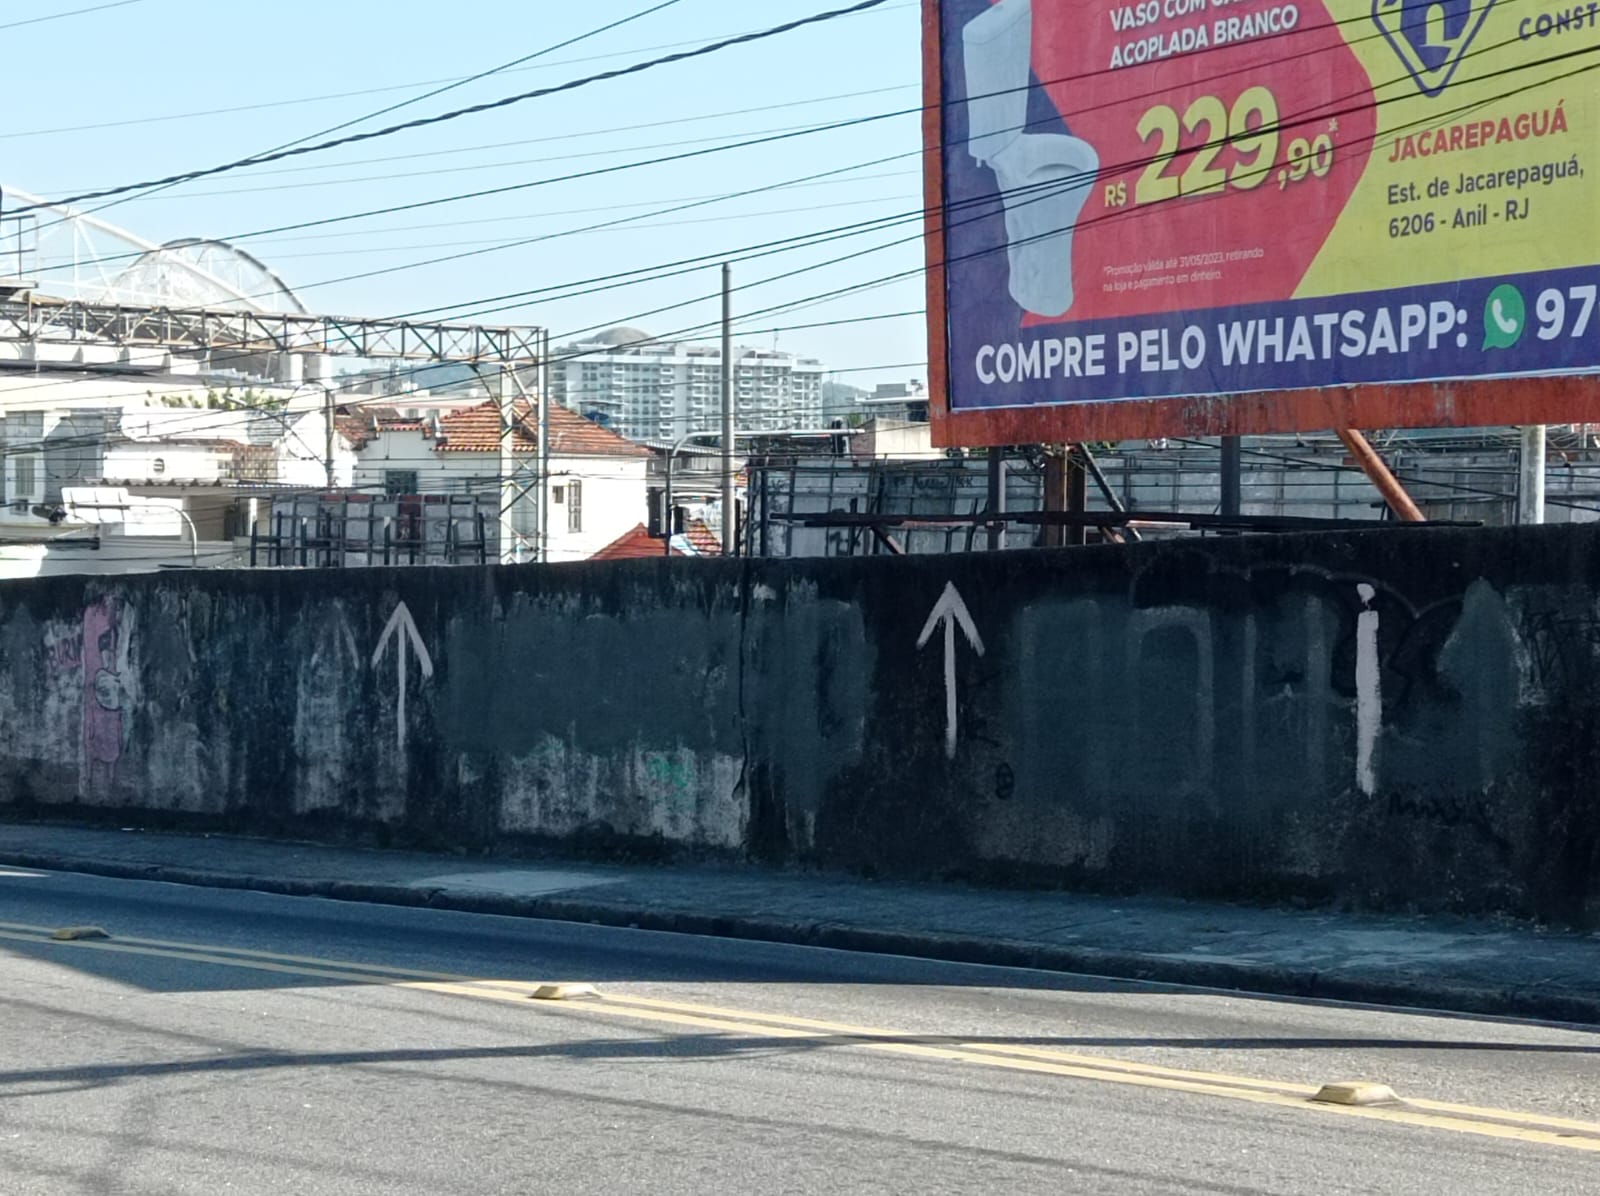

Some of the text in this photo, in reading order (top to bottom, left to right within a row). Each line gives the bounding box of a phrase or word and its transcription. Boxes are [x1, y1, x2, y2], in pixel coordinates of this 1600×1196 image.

[1109, 7, 1159, 32] VASO
[1109, 4, 1299, 69] ACOPLADA BRANCO
[1388, 98, 1569, 163] JACAREPAGUÁ
[1104, 180, 1127, 207] R$
[1387, 153, 1585, 205] Est. de Jacarepaguá,
[1388, 212, 1435, 239] 6206
[1452, 203, 1488, 230] Anil
[1505, 198, 1530, 222] RJ
[1225, 247, 1264, 262] retirando
[1133, 274, 1176, 291] pagamento
[1176, 274, 1189, 284] em
[975, 284, 1600, 385] COMPRE PELO WHATSAPP: 97
